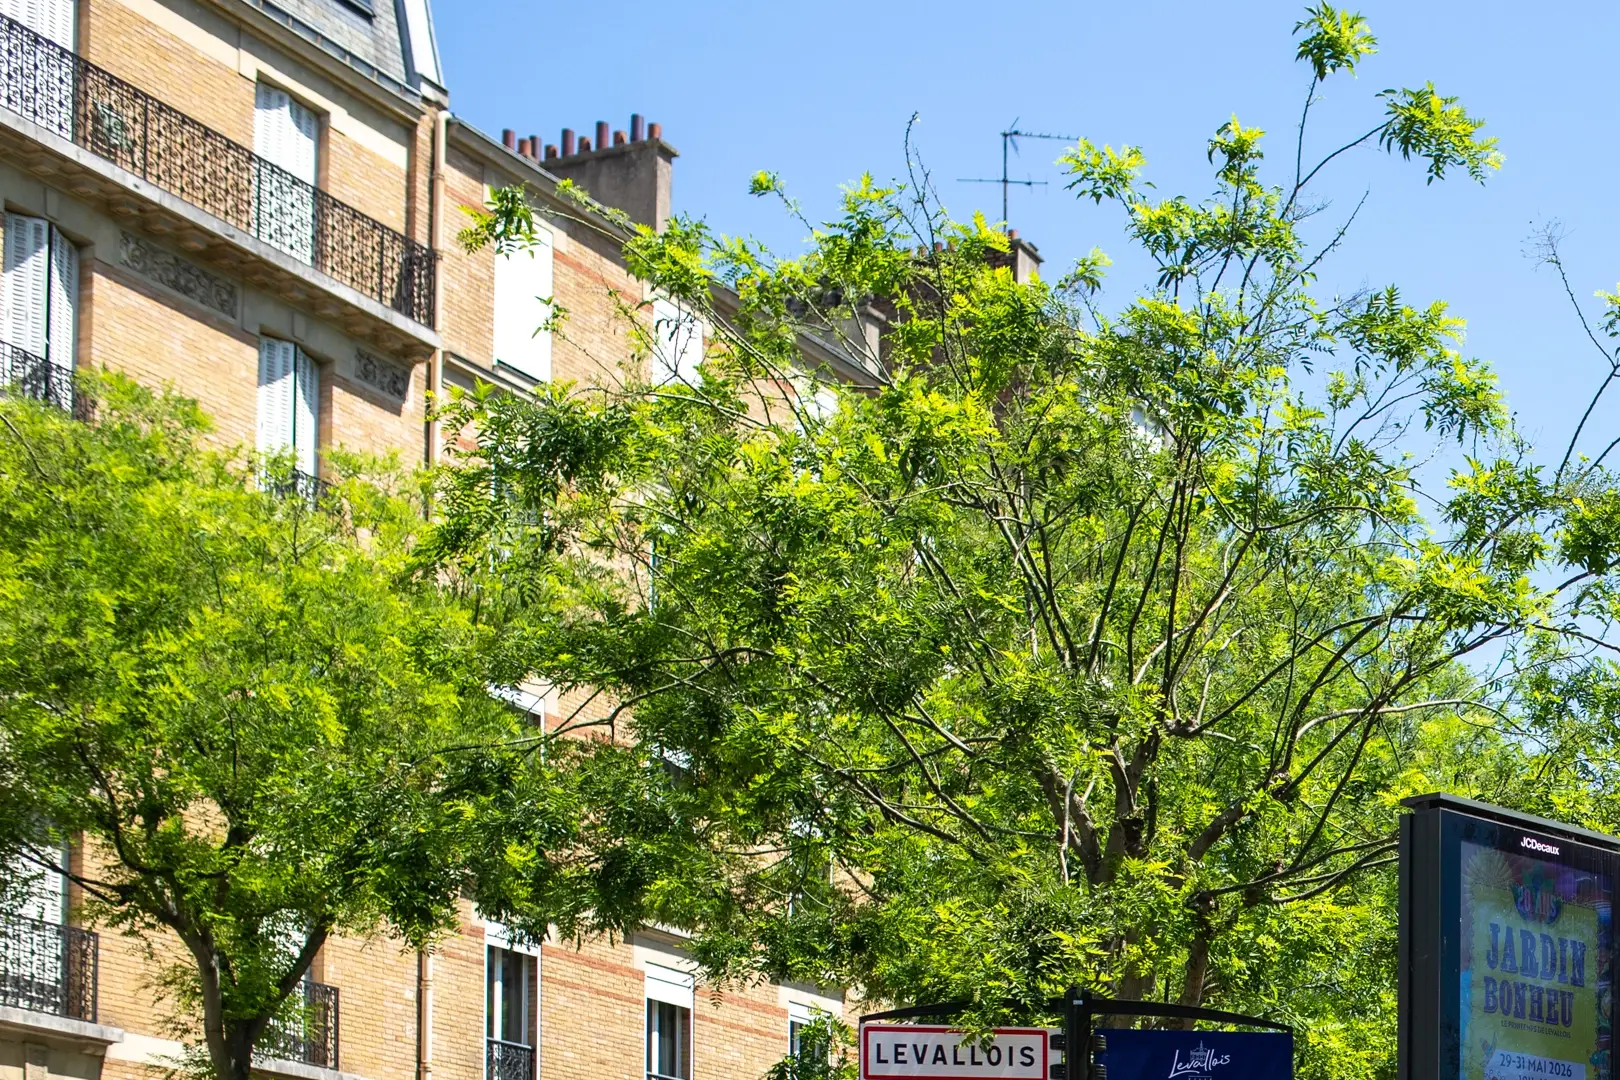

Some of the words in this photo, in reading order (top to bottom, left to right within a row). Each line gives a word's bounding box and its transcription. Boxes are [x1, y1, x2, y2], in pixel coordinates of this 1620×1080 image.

[1521, 836, 1560, 856] JCDecaux
[1486, 922, 1586, 988] JARDIN
[1508, 1021, 1537, 1033] PRINTEMPS
[1538, 1026, 1544, 1035] DE
[1545, 1027, 1571, 1039] LEVALLOIS
[876, 1043, 1036, 1067] LEVALLOIS
[1168, 1049, 1231, 1079] Levallois
[1500, 1053, 1526, 1071] 29-31
[1528, 1058, 1546, 1074] MAI
[1548, 1062, 1573, 1077] 2026
